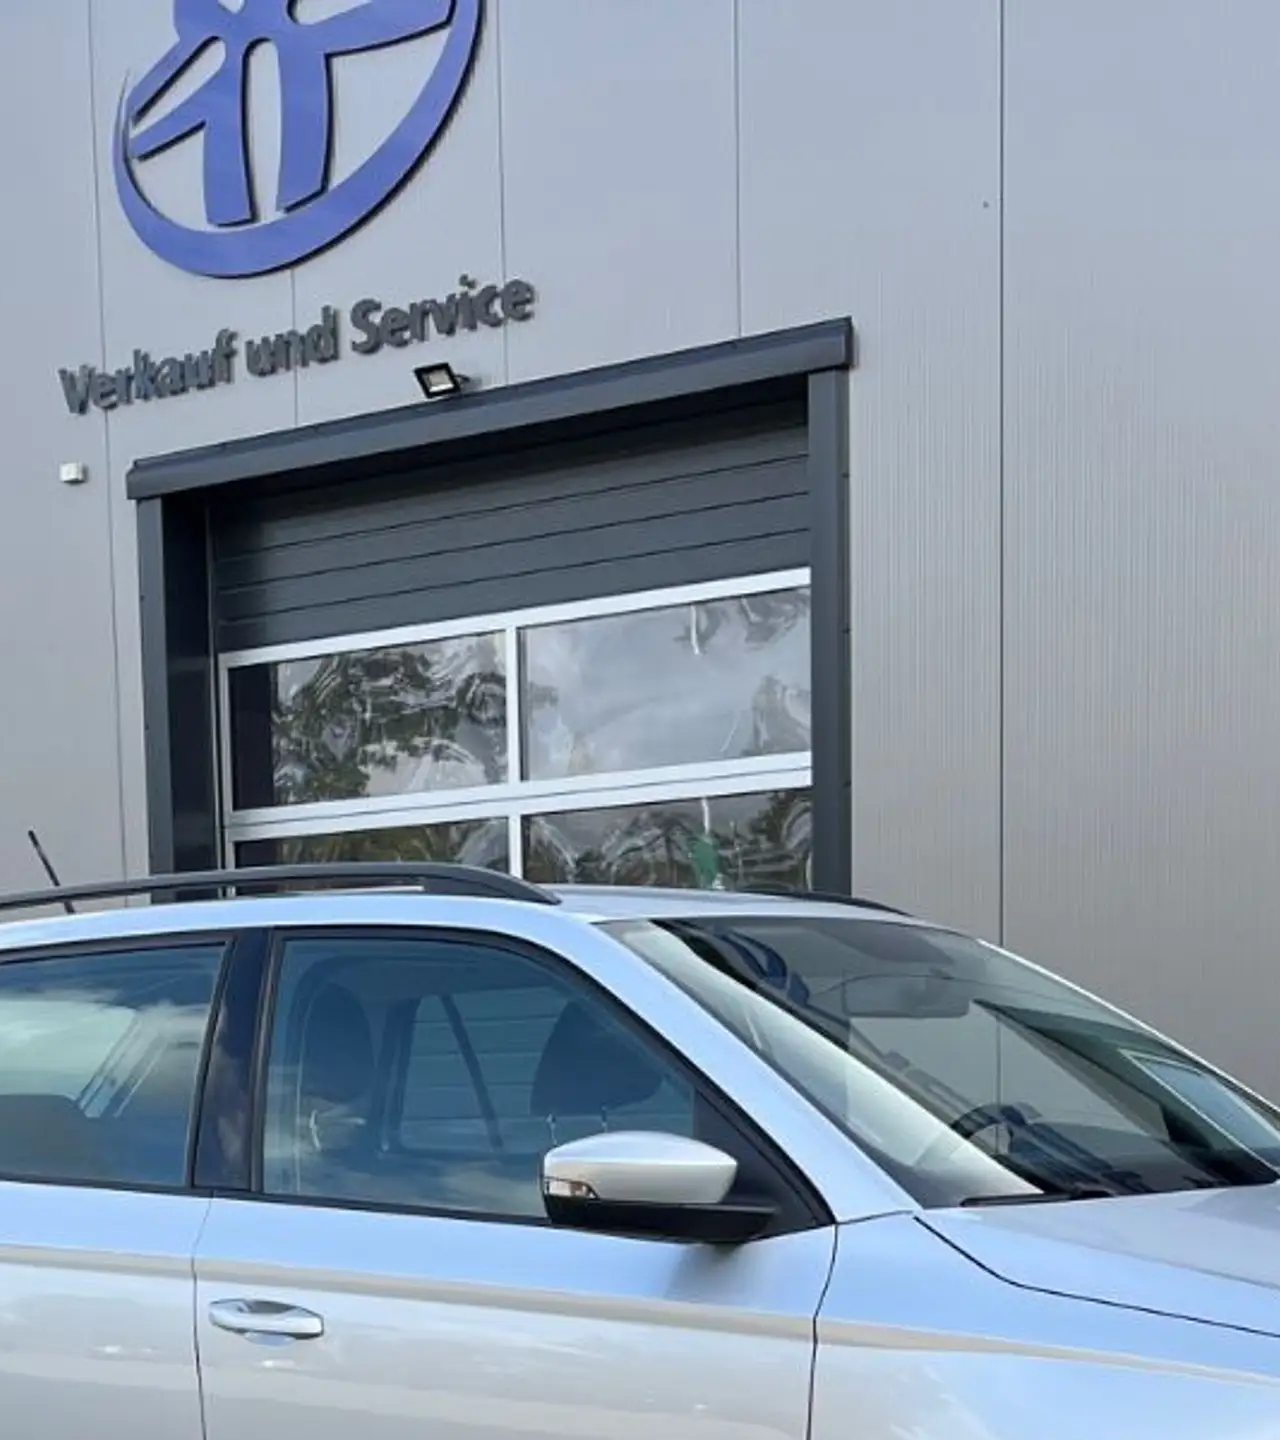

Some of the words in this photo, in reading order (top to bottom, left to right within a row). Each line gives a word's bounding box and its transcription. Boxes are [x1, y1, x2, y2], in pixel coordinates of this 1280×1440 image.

[59, 329, 238, 415] Verkauf
[245, 305, 342, 377] und
[350, 274, 536, 355] Service
